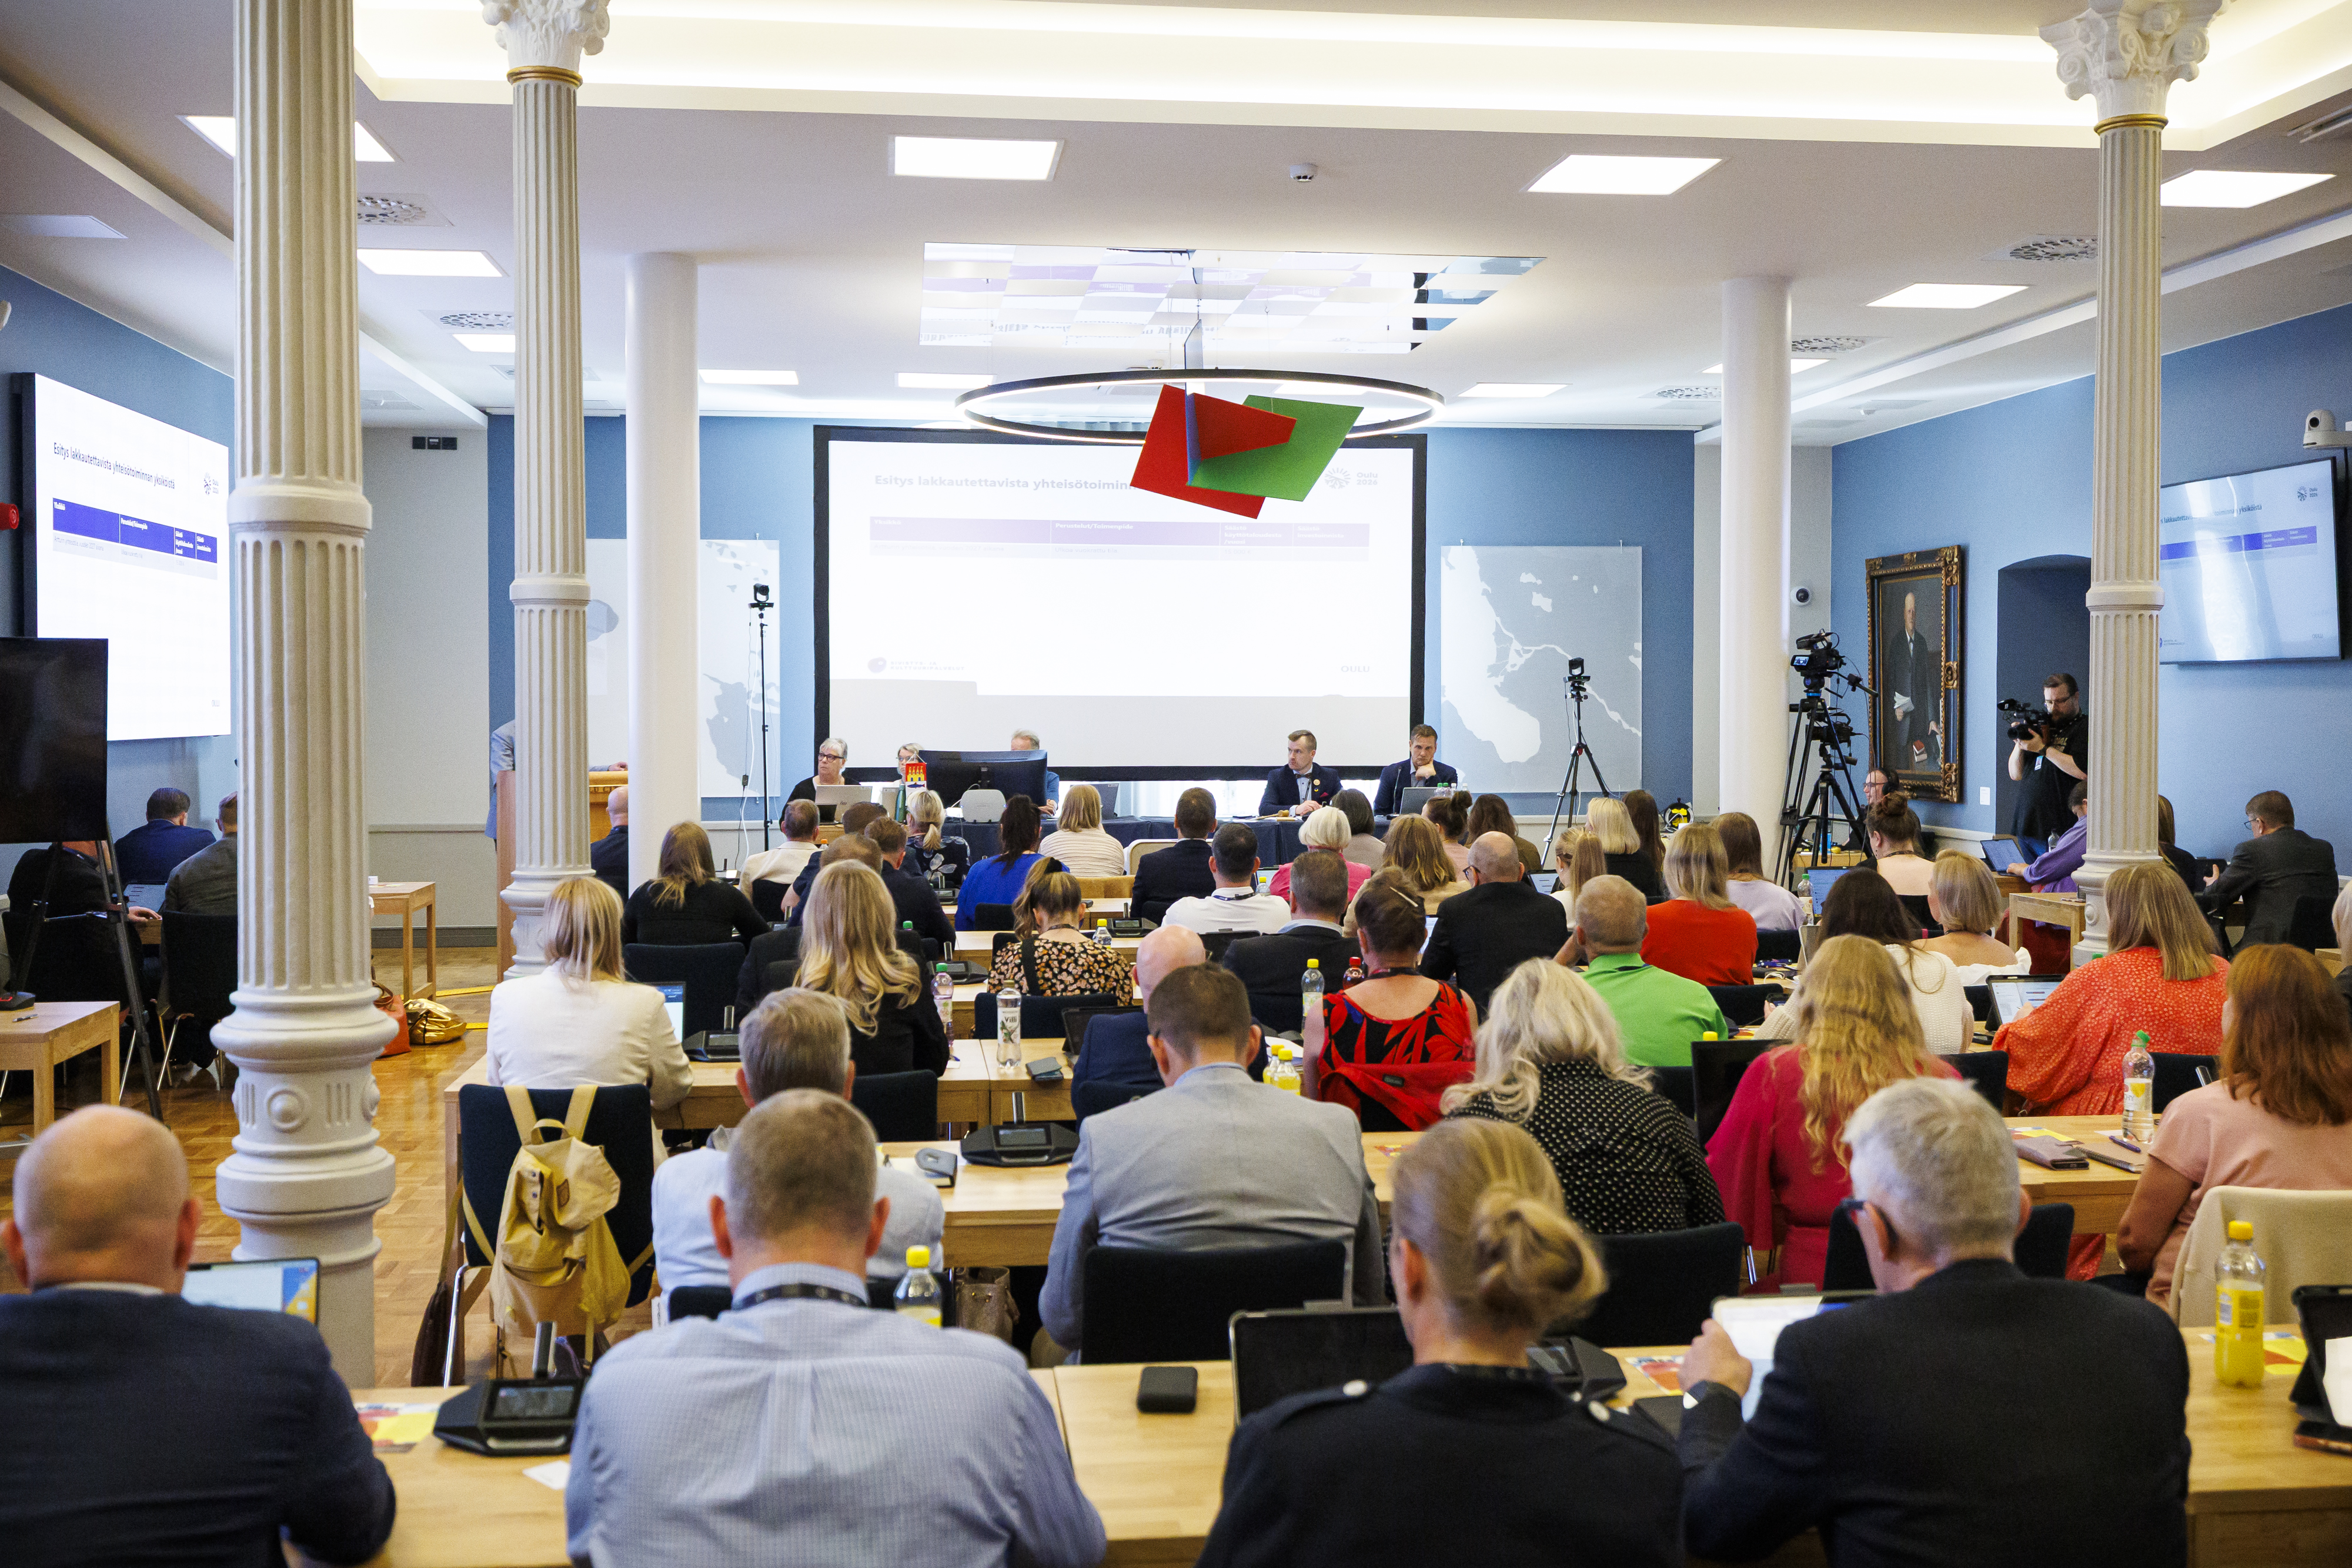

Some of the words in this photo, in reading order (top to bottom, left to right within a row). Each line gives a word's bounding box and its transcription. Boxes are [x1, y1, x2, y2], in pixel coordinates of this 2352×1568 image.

[54, 442, 69, 460] Esitys
[71, 446, 112, 470] lakkautettavista
[112, 461, 153, 483] yhteisötoiminnan
[875, 475, 914, 488] Esitys
[918, 476, 1029, 489] lakkautettavista
[1033, 479, 1137, 491] yhteisötoimin
